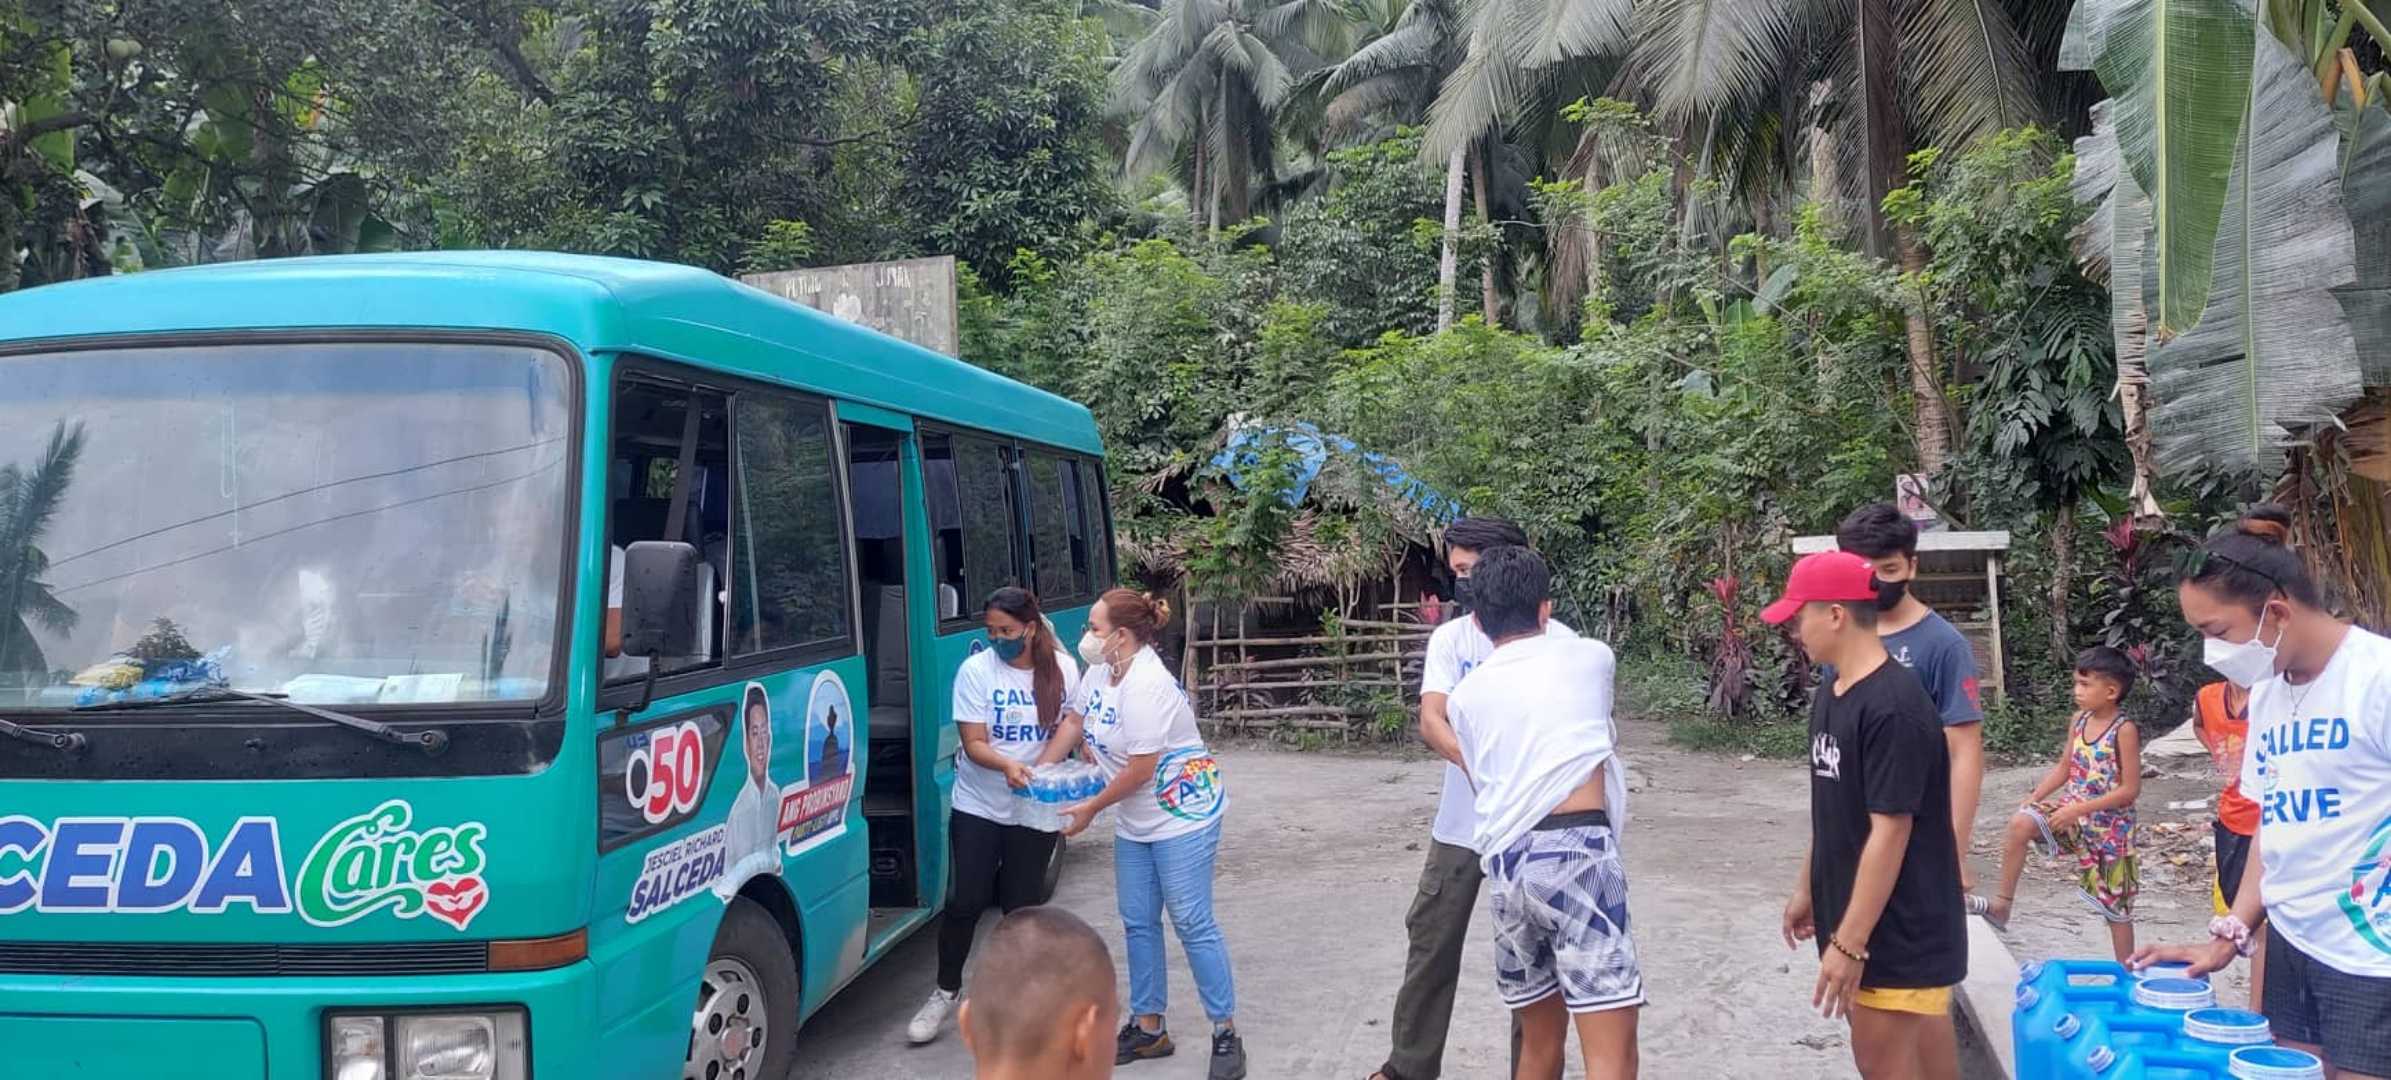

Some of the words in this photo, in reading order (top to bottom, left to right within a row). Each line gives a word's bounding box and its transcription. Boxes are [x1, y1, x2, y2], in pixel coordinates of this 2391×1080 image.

[992, 725, 1056, 741] SERV
[2261, 787, 2342, 826] ERVE
[685, 828, 725, 857] RICHARD
[295, 799, 488, 928] Cares
[628, 846, 726, 918] SALCEDA
